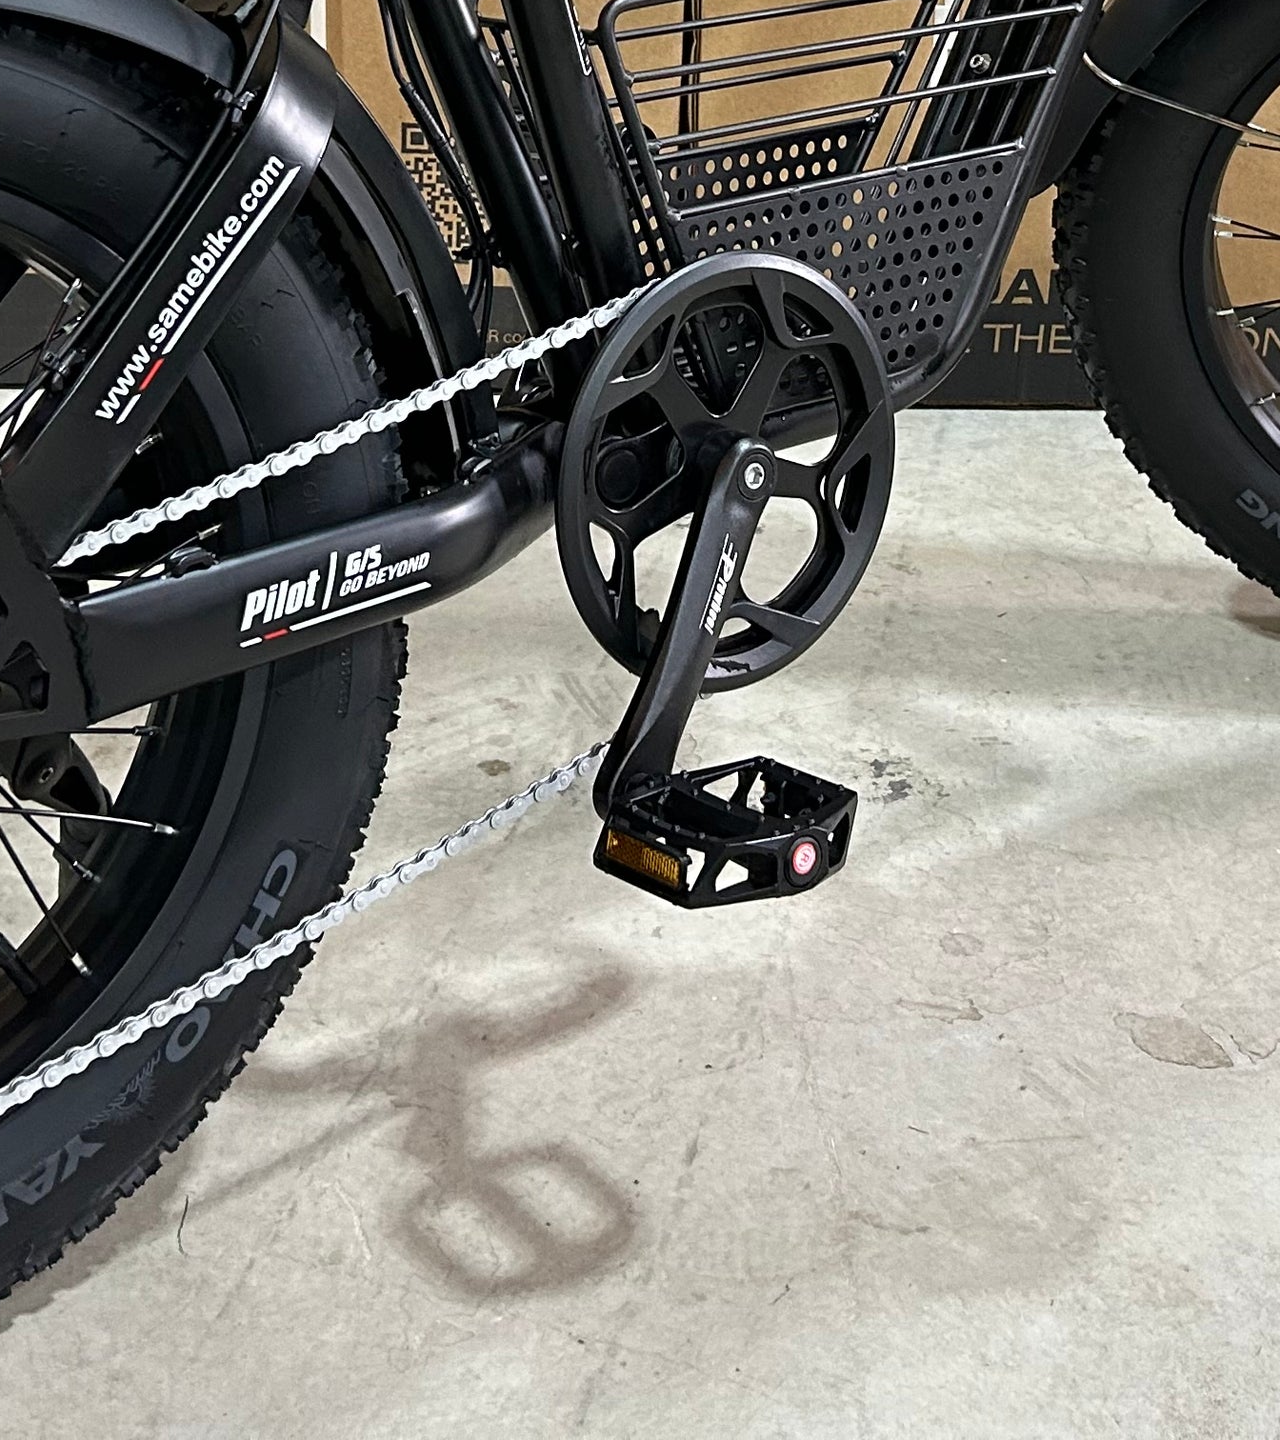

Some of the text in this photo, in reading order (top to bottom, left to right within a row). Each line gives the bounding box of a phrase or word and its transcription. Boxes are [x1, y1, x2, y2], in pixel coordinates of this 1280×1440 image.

[94, 154, 286, 421] www.samebike.com
[239, 543, 382, 632] Pilot G/S
[339, 551, 431, 597] GO BEYOND
[165, 848, 298, 1063] CHO
